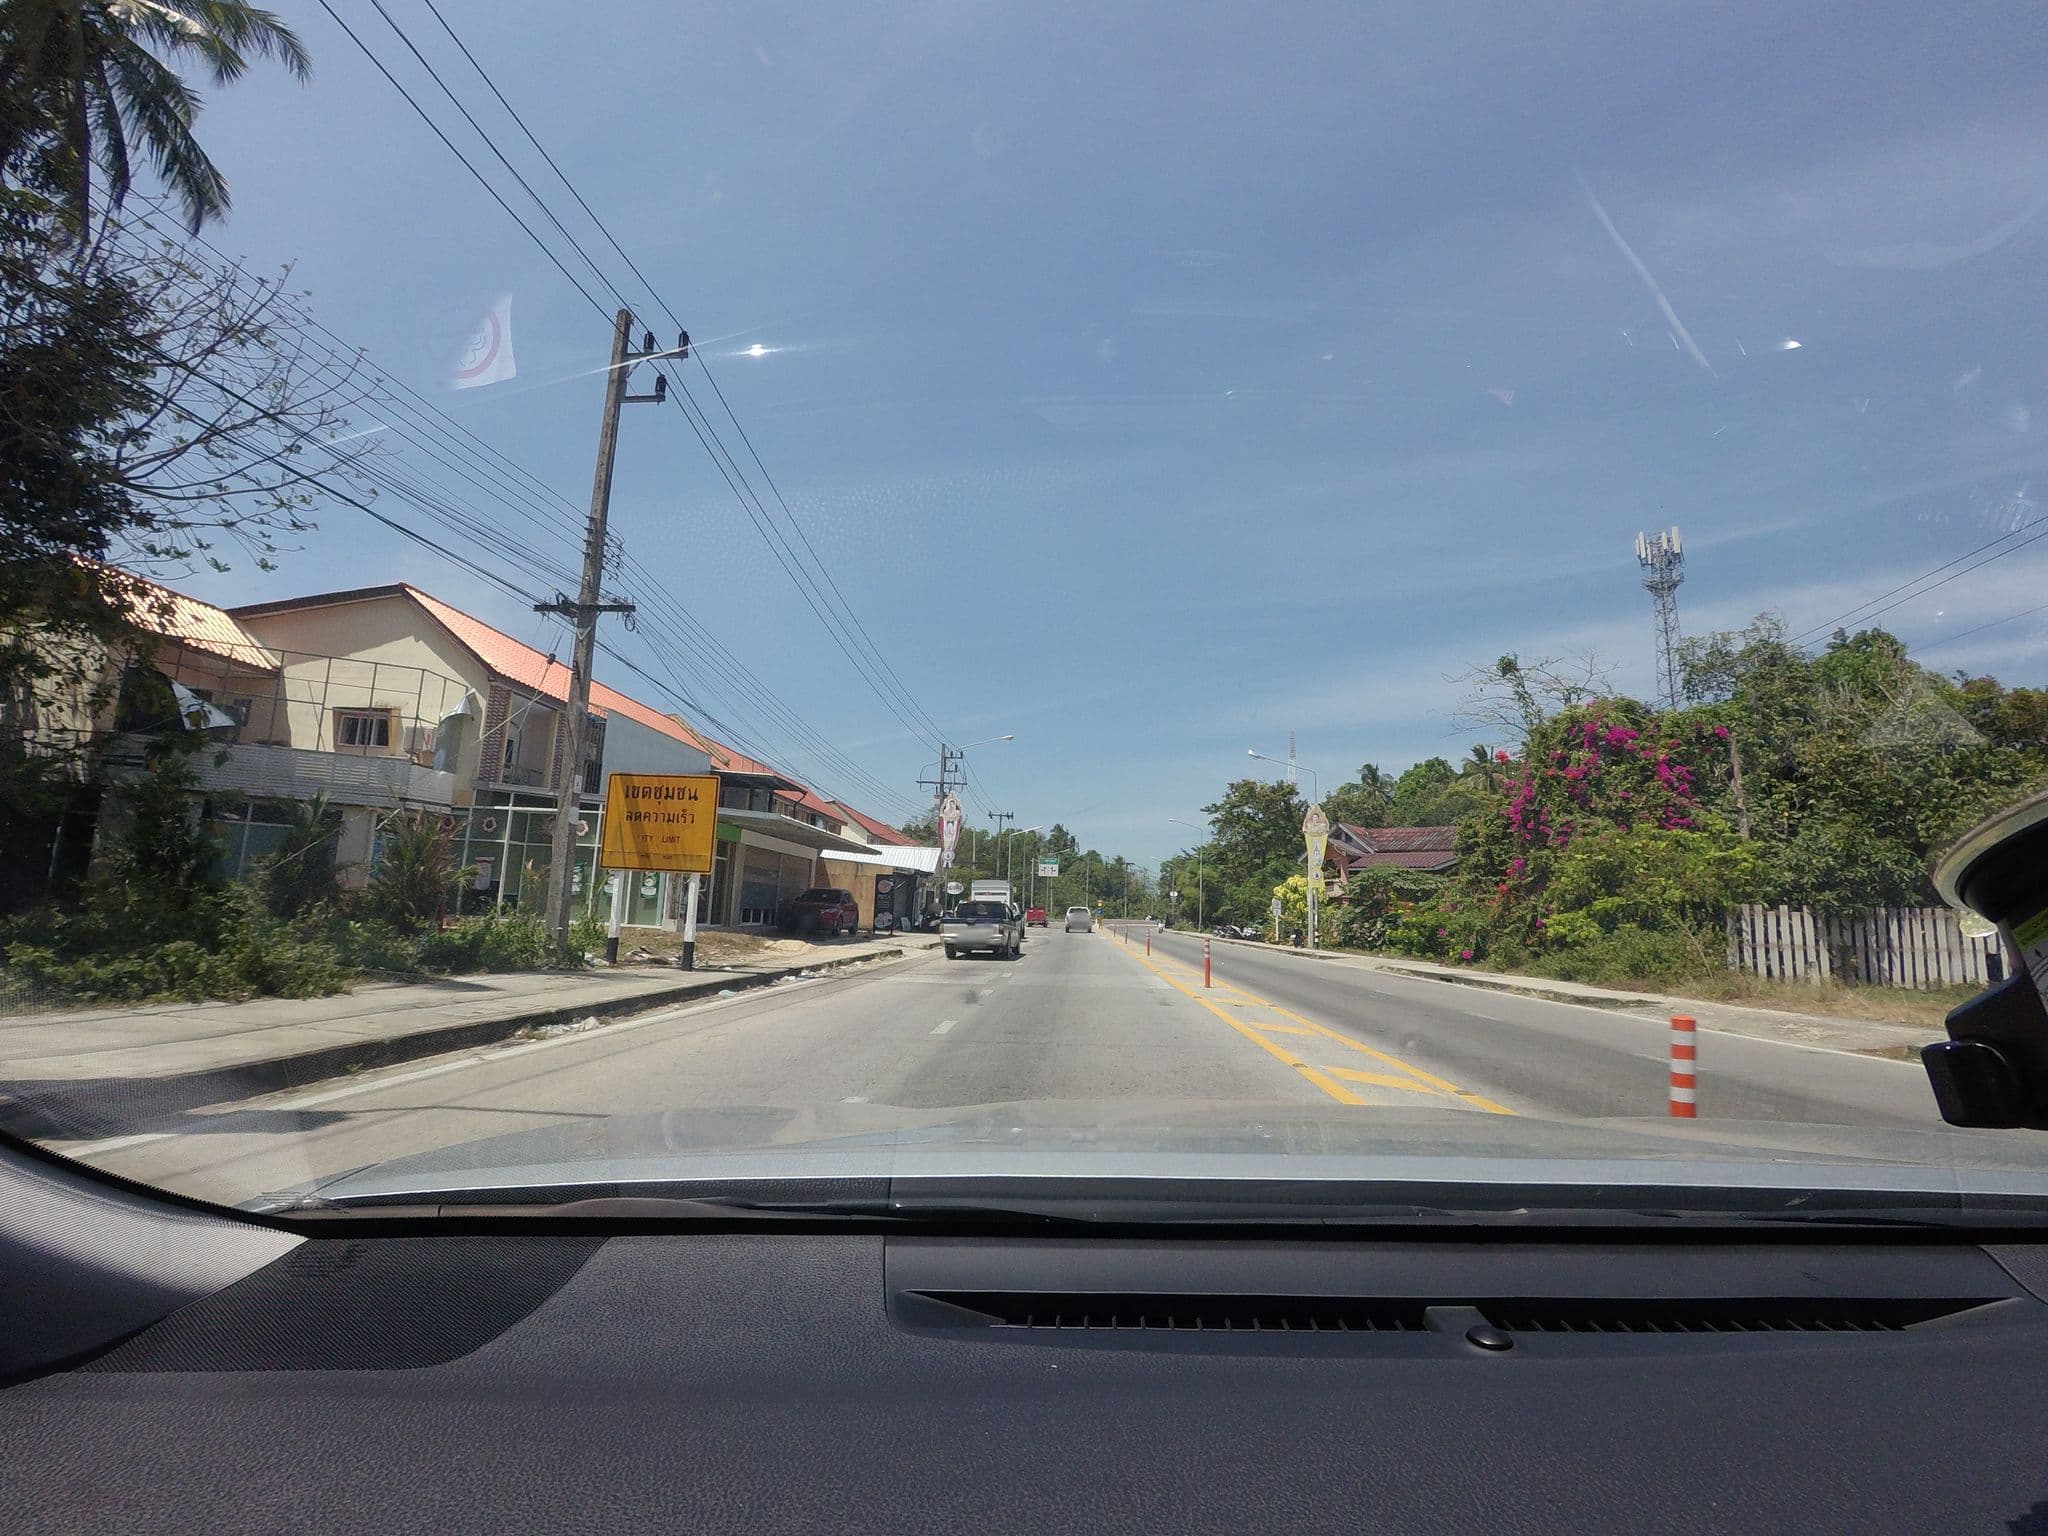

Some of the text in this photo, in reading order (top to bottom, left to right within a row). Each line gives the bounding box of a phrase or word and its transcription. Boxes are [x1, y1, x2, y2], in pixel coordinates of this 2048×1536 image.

[625, 785, 699, 806] เขตชุมชน
[625, 808, 695, 824] ลดความเร็ว
